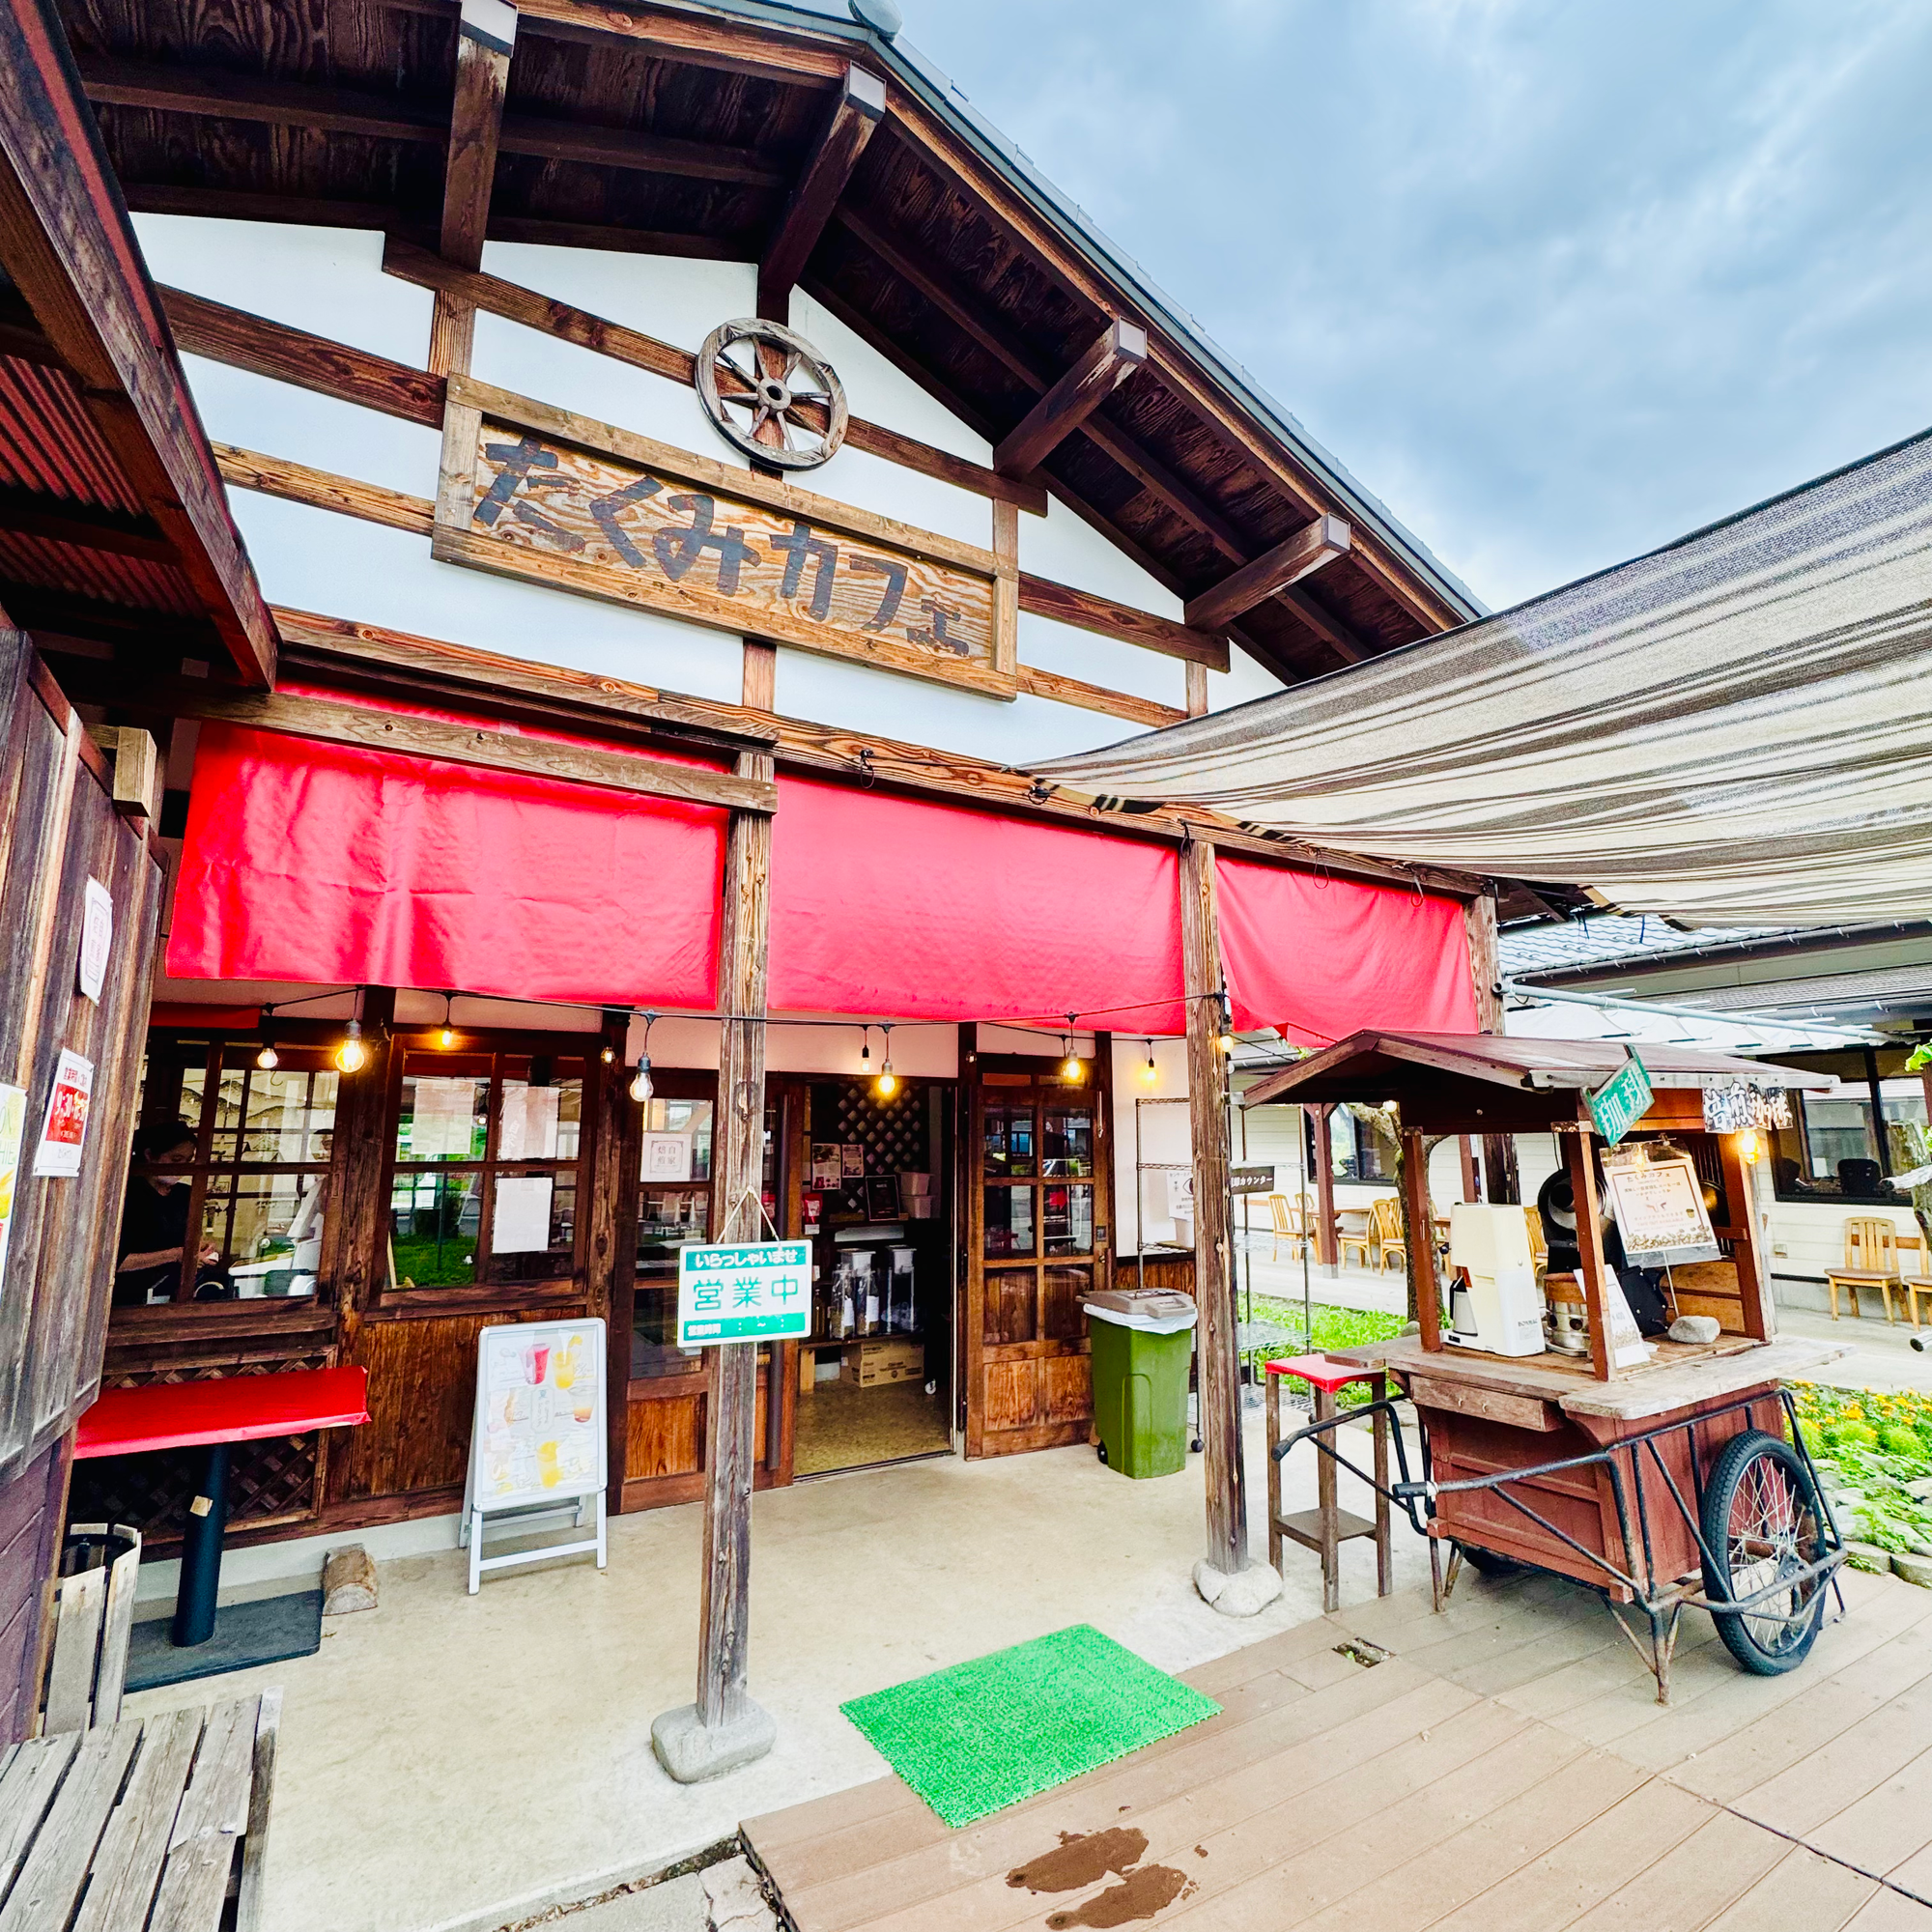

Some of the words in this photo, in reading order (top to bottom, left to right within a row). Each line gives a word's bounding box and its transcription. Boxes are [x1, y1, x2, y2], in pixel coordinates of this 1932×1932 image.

[474, 434, 970, 659] たくみカフェ
[695, 1249, 798, 1268] いらっしゃいませ
[693, 1273, 799, 1312] 営業中
